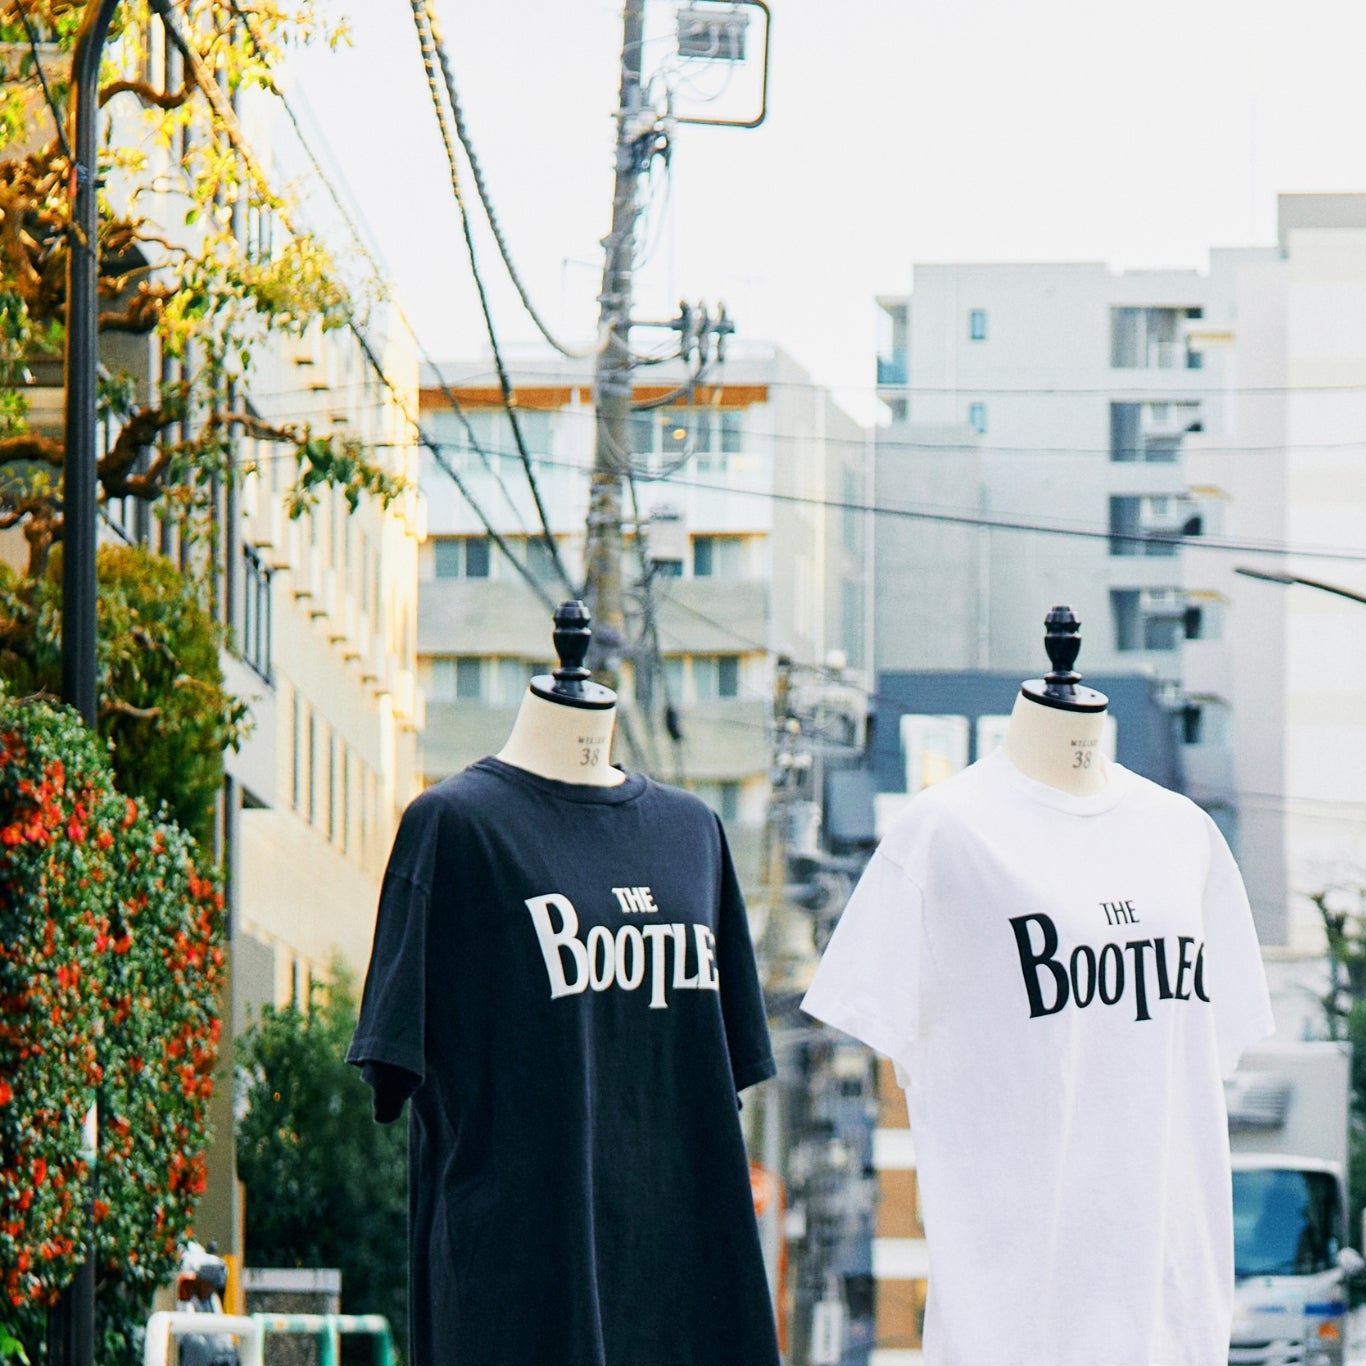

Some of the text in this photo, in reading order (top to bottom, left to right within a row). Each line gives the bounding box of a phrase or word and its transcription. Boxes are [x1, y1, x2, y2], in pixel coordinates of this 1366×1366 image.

[579, 747, 600, 766] 38
[1072, 750, 1092, 769] 38
[611, 887, 659, 913] THE
[1099, 900, 1140, 926] THE
